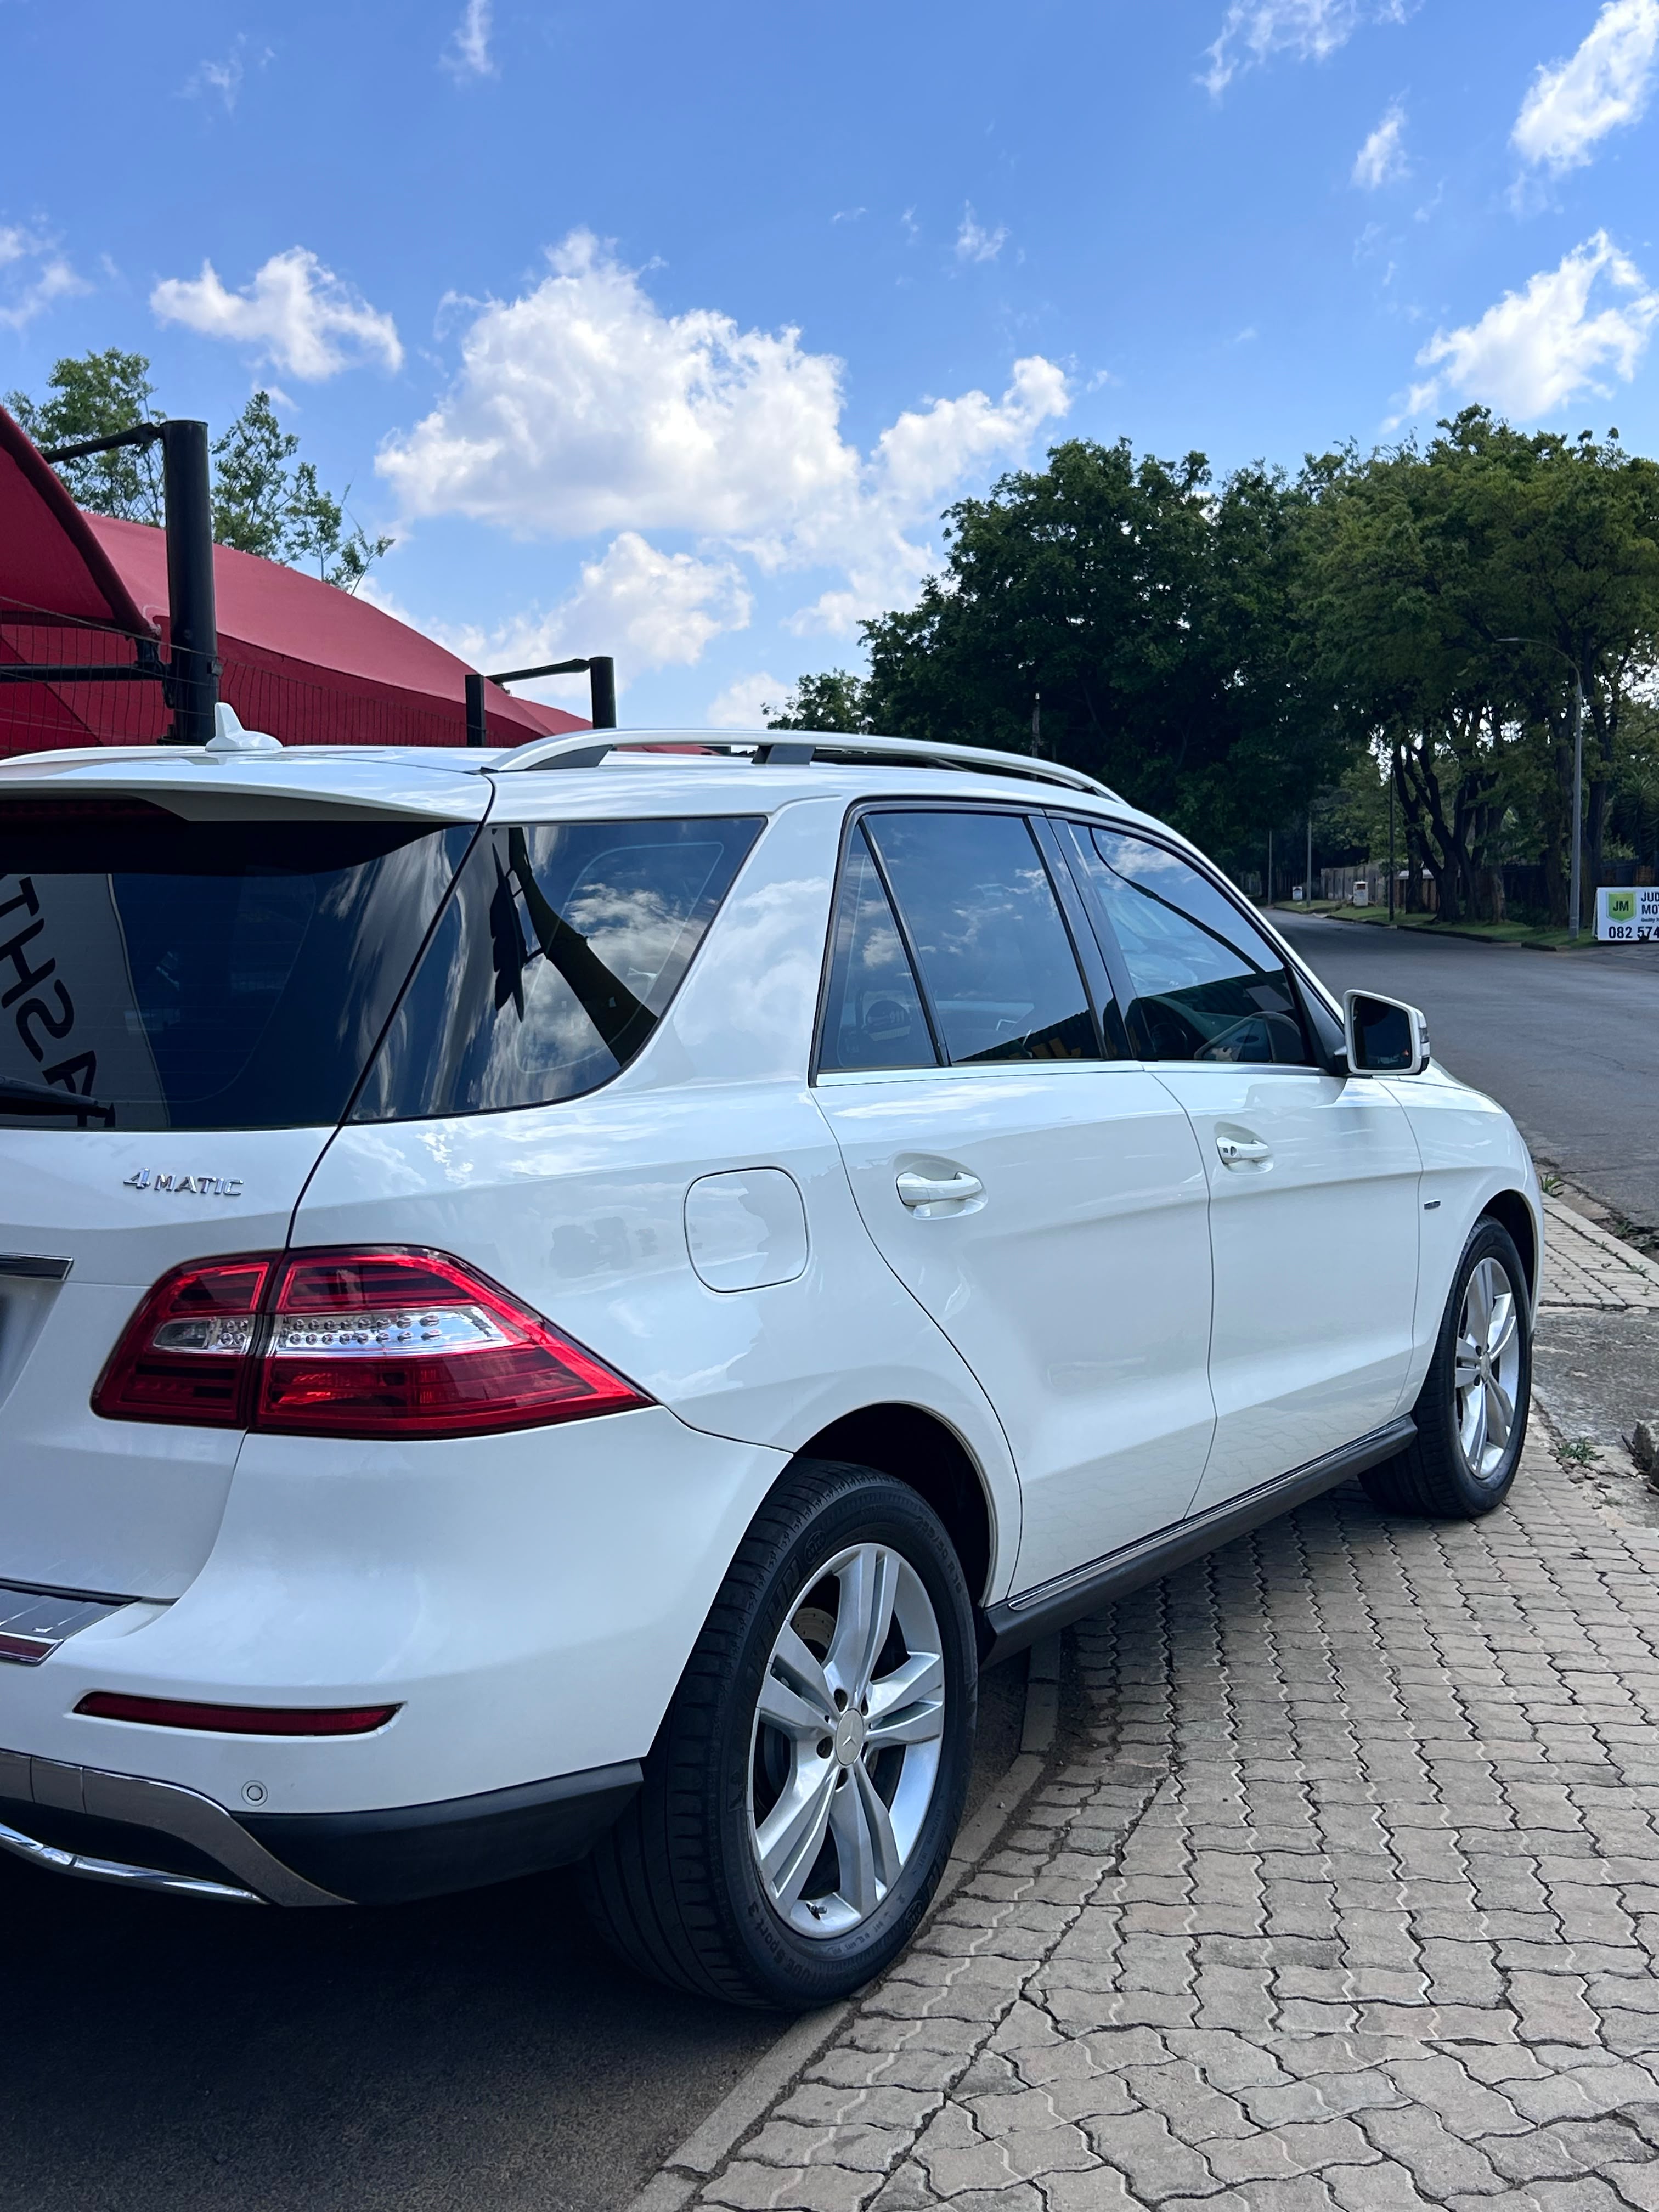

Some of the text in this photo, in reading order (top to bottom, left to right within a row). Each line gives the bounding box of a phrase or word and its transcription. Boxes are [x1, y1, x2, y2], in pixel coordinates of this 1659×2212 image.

[1613, 900, 1629, 911] JM
[1641, 904, 1659, 915] MO
[1609, 926, 1659, 939] 082 574
[123, 1167, 243, 1195] 4MATIC
[747, 1900, 760, 1918] 3
[754, 1918, 787, 1965] Sport
